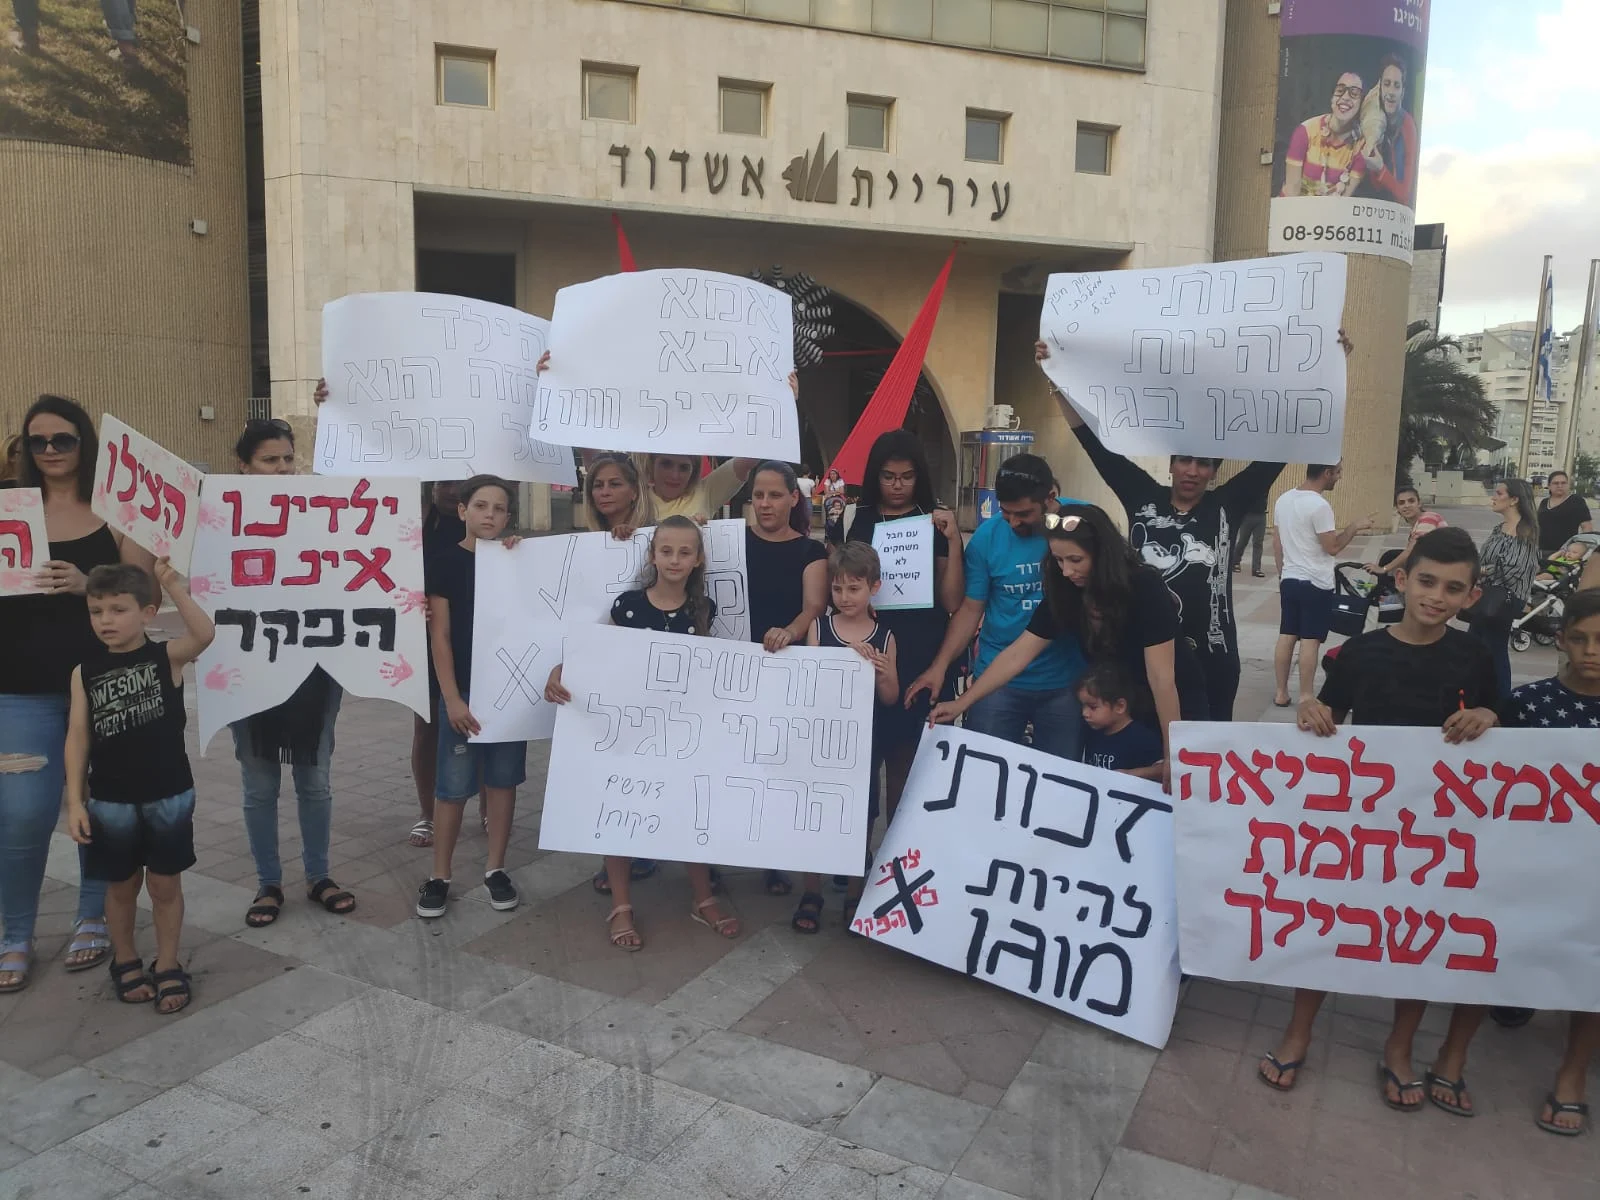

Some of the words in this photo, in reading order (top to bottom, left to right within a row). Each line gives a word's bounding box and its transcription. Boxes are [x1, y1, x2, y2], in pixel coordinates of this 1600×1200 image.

[608, 143, 765, 199] אשדוד
[850, 166, 1010, 221] עיריית
[1282, 225, 1383, 245] 08-9568111
[1353, 205, 1396, 221] כרטיסים
[660, 277, 780, 333] אמא
[1142, 262, 1323, 316] זכותי
[421, 303, 547, 362] הילד
[658, 330, 783, 382] אבא
[1124, 315, 1323, 374] להיות
[343, 356, 442, 405] הוא
[323, 410, 476, 468] כולנו!
[1088, 385, 1185, 438] בגן
[1206, 387, 1333, 441] מוגן
[106, 433, 187, 540] הצילו
[222, 477, 399, 538] ילדינו
[883, 543, 919, 554] משחקים
[895, 556, 907, 566] לא
[905, 529, 918, 538] עם
[231, 547, 396, 593] אינם
[214, 607, 397, 663] הפקר
[90, 663, 161, 712] AWESOME
[645, 641, 861, 710] דורשים
[586, 692, 702, 760] לגיל
[722, 712, 859, 769] שינוי
[922, 740, 1174, 863] זכותי
[1178, 735, 1396, 814] לביאה
[1432, 759, 1600, 825] אמא
[1242, 808, 1480, 889] נלחמת
[964, 858, 1152, 939] להיות
[1223, 872, 1499, 973] בשבילך
[966, 907, 1133, 1017] מוגן
